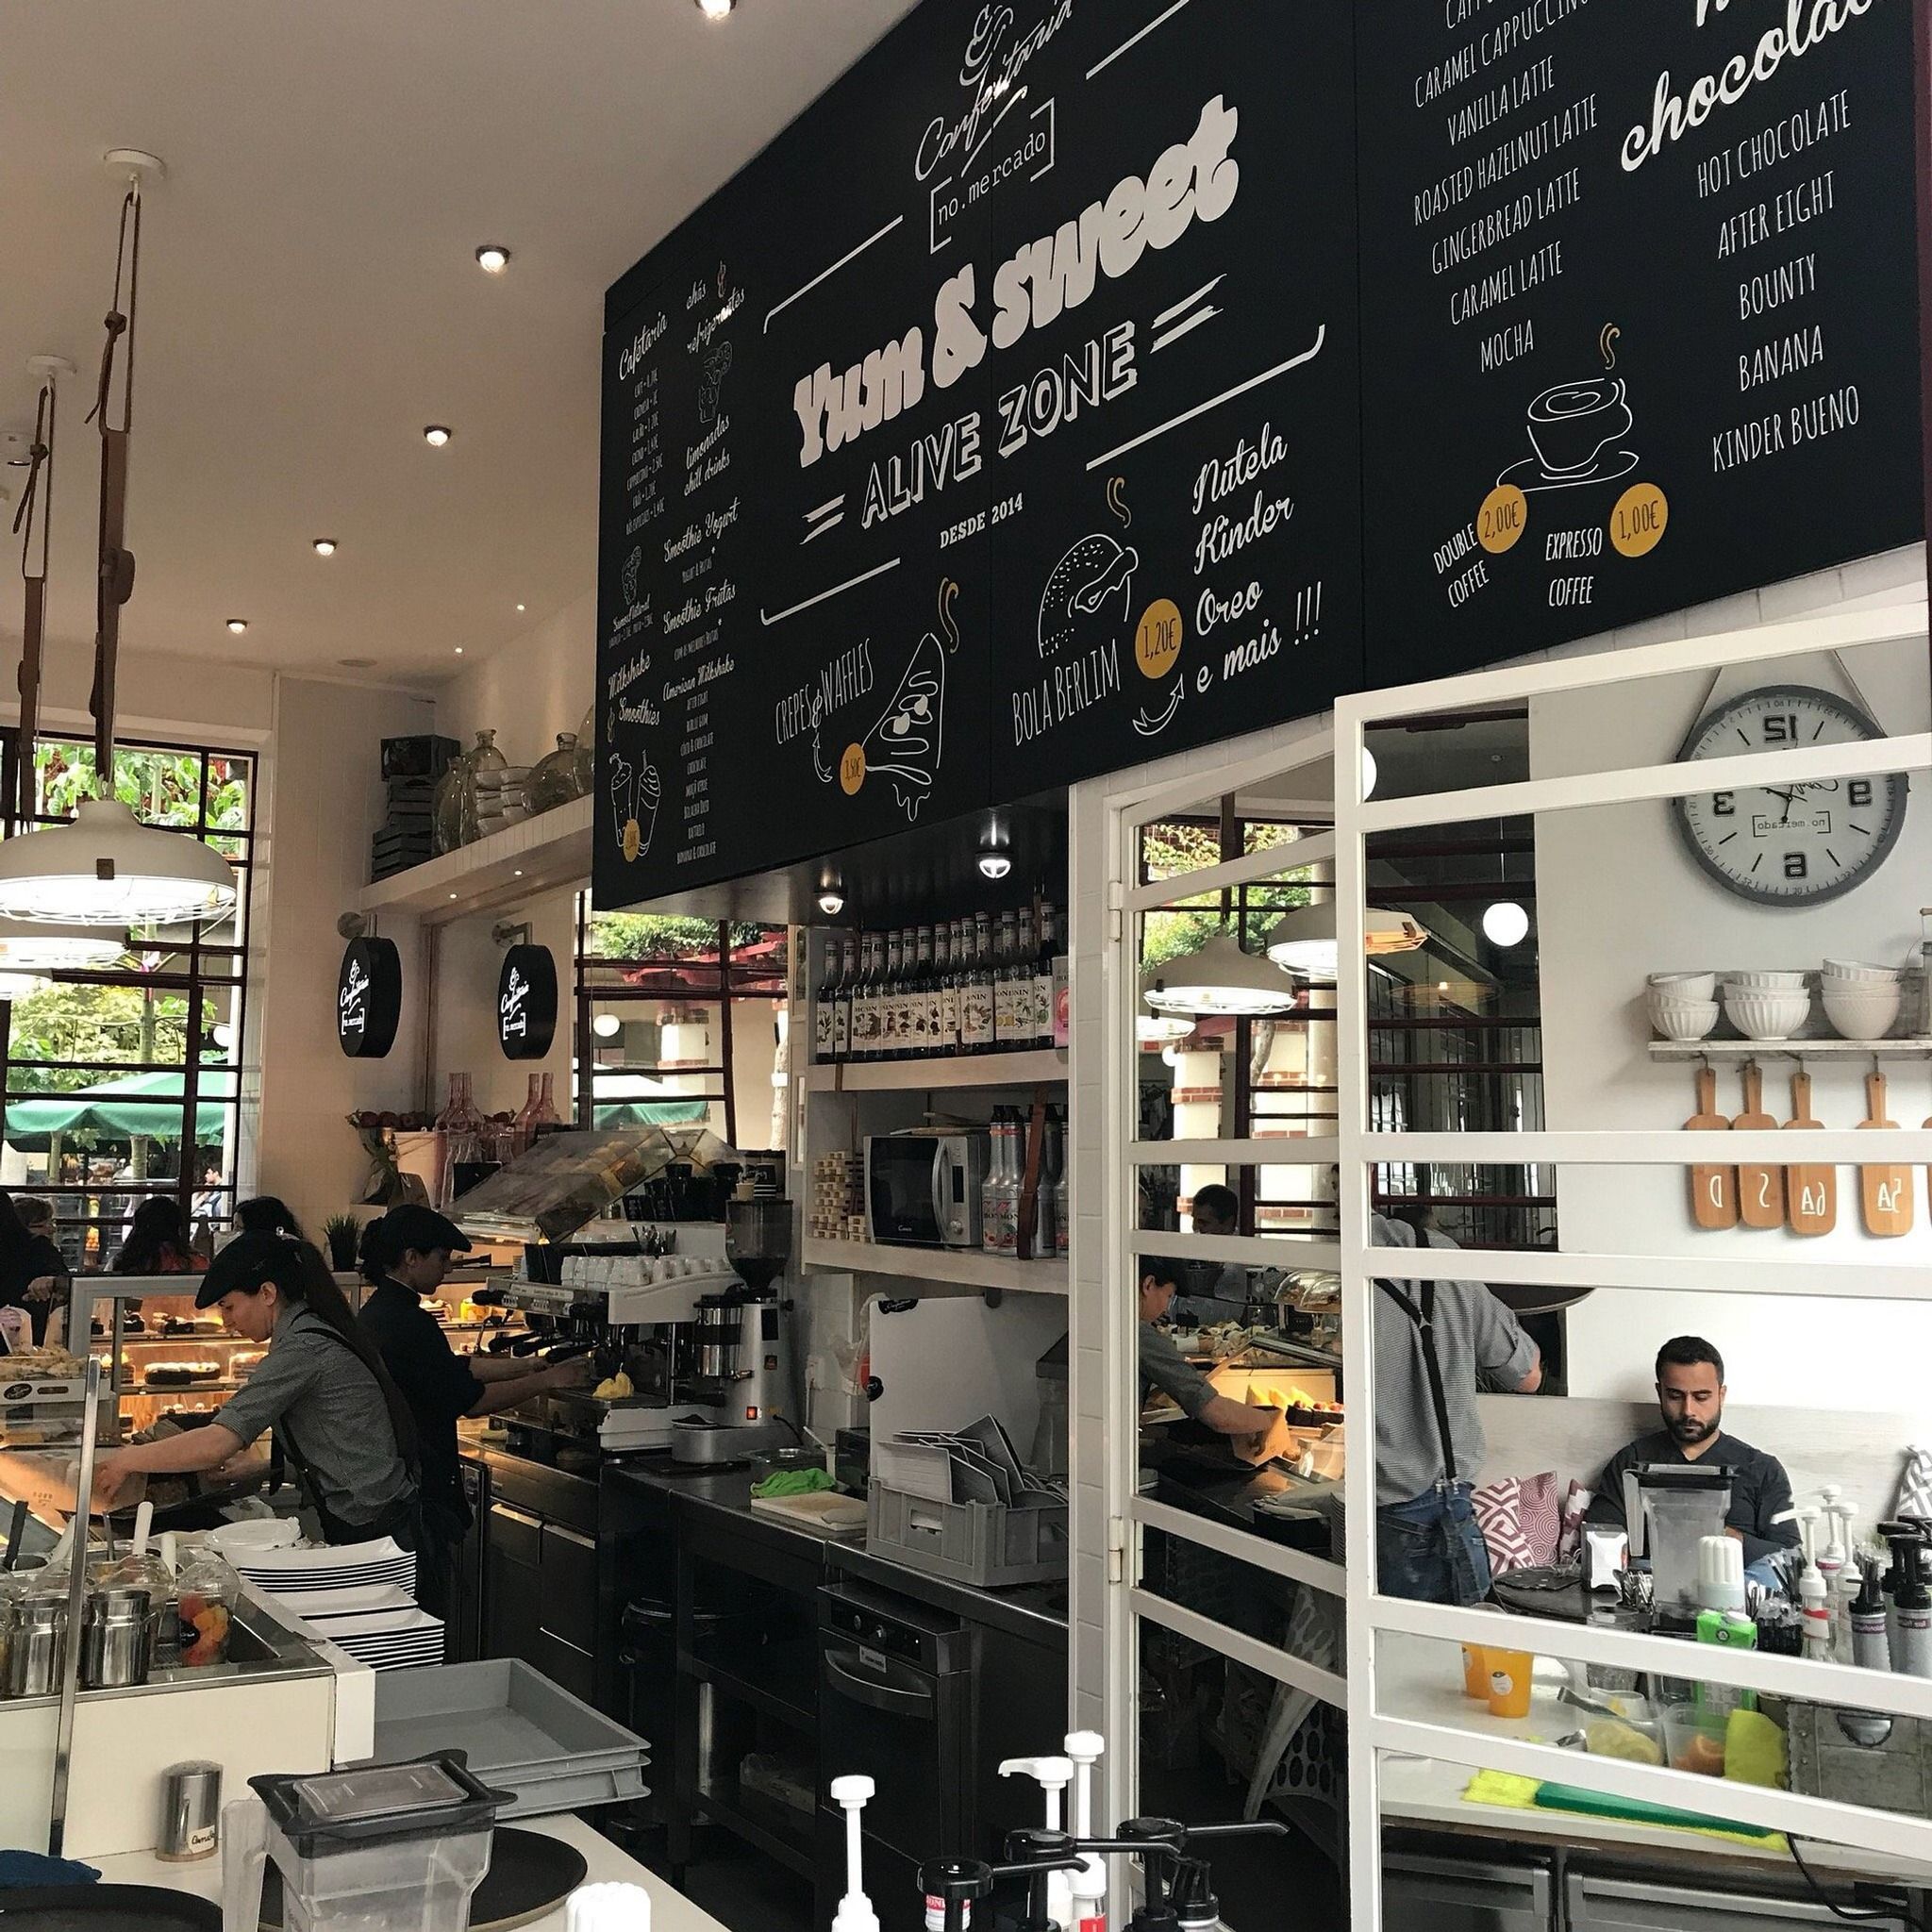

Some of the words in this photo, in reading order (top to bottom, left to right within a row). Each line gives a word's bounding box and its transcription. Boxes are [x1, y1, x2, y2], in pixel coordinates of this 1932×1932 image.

[1415, 43, 1477, 108] CARAMEL
[1482, 0, 1588, 66] CAPPUCCIN
[1447, 84, 1508, 146] VANILLA
[1513, 55, 1555, 108] LATTE
[1414, 166, 1474, 226] ROASTED
[1477, 121, 1549, 190] HAZELNUT
[1554, 93, 1597, 148] LATTE
[1697, 149, 1731, 198] HOT
[1738, 90, 1852, 178] CHOCOLATE
[1432, 194, 1532, 275] GINGERBREAD
[1538, 167, 1581, 220] LATTE
[1718, 203, 1770, 259] AFTER
[1776, 171, 1834, 234] EIGHT
[793, 326, 925, 468] Yum
[932, 263, 987, 389] &
[992, 93, 1240, 349] sweet
[1450, 264, 1516, 325] CARAMEL
[1520, 241, 1563, 292] LATTE
[1740, 253, 1815, 321] BOUNTY
[619, 311, 668, 381] Cafetaria
[1481, 319, 1534, 373] MOCHA
[1739, 325, 1824, 391] BANANA
[861, 412, 981, 529] ALIVE
[998, 320, 1138, 458] ZONE
[1712, 413, 1785, 473] KINDER
[1791, 385, 1859, 445] BUENO
[705, 447, 730, 481] drinks
[1192, 422, 1288, 515] Nutela
[664, 525, 702, 562] Smoothie
[706, 496, 741, 540] Yogurt
[940, 513, 985, 549] DESDE
[991, 492, 1024, 526] 2014
[1194, 490, 1294, 575] Kinder
[1433, 523, 1478, 575] DOUBLE
[1484, 500, 1521, 539] 2,00€
[1545, 526, 1603, 561] EXPRESSO
[1618, 500, 1660, 541] 1,00€
[663, 597, 702, 634] Smoothie
[1195, 581, 1264, 636] Oreo
[1447, 559, 1491, 608] COFFEE
[1548, 575, 1594, 607] COFFEE
[1143, 619, 1177, 661] 1,20€
[1196, 665, 1213, 693] e
[1224, 619, 1282, 680] mais
[619, 696, 659, 725] Smoothies
[775, 683, 812, 744] CREPES
[821, 638, 874, 716] WAFFLES
[1012, 680, 1053, 746] BOLA
[1056, 638, 1121, 723] BERLIM
